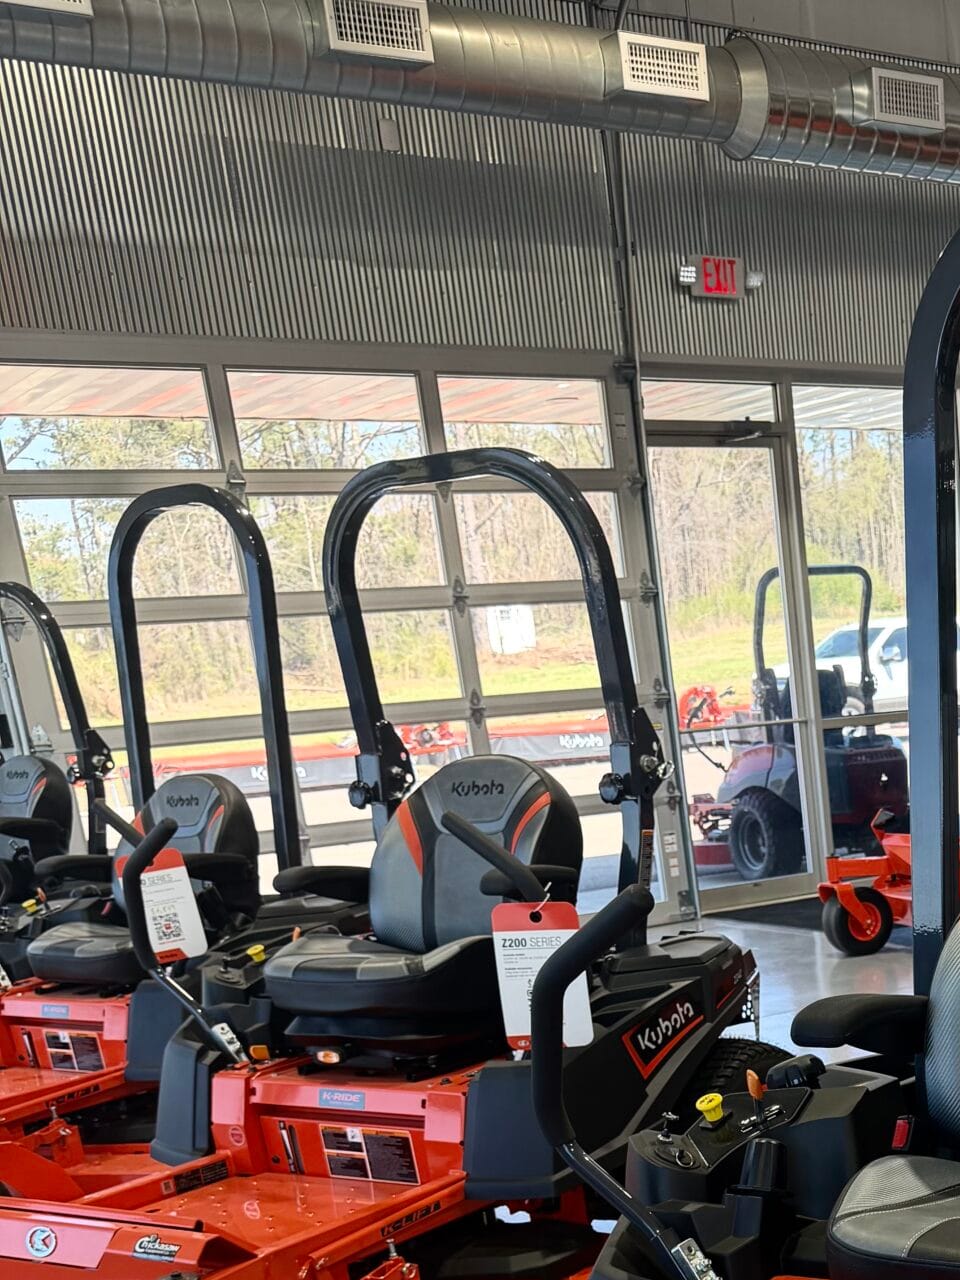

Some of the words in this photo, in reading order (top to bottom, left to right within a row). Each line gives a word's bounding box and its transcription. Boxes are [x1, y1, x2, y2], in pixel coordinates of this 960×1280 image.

[702, 257, 737, 295] EXIT
[560, 734, 604, 748] Kubota
[452, 779, 504, 797] Kubota
[166, 794, 199, 807] Kubota
[501, 938, 527, 948] Z200
[530, 936, 562, 947] SERIES
[638, 1002, 695, 1050] Kubota
[322, 1091, 361, 1102] K-RIDE
